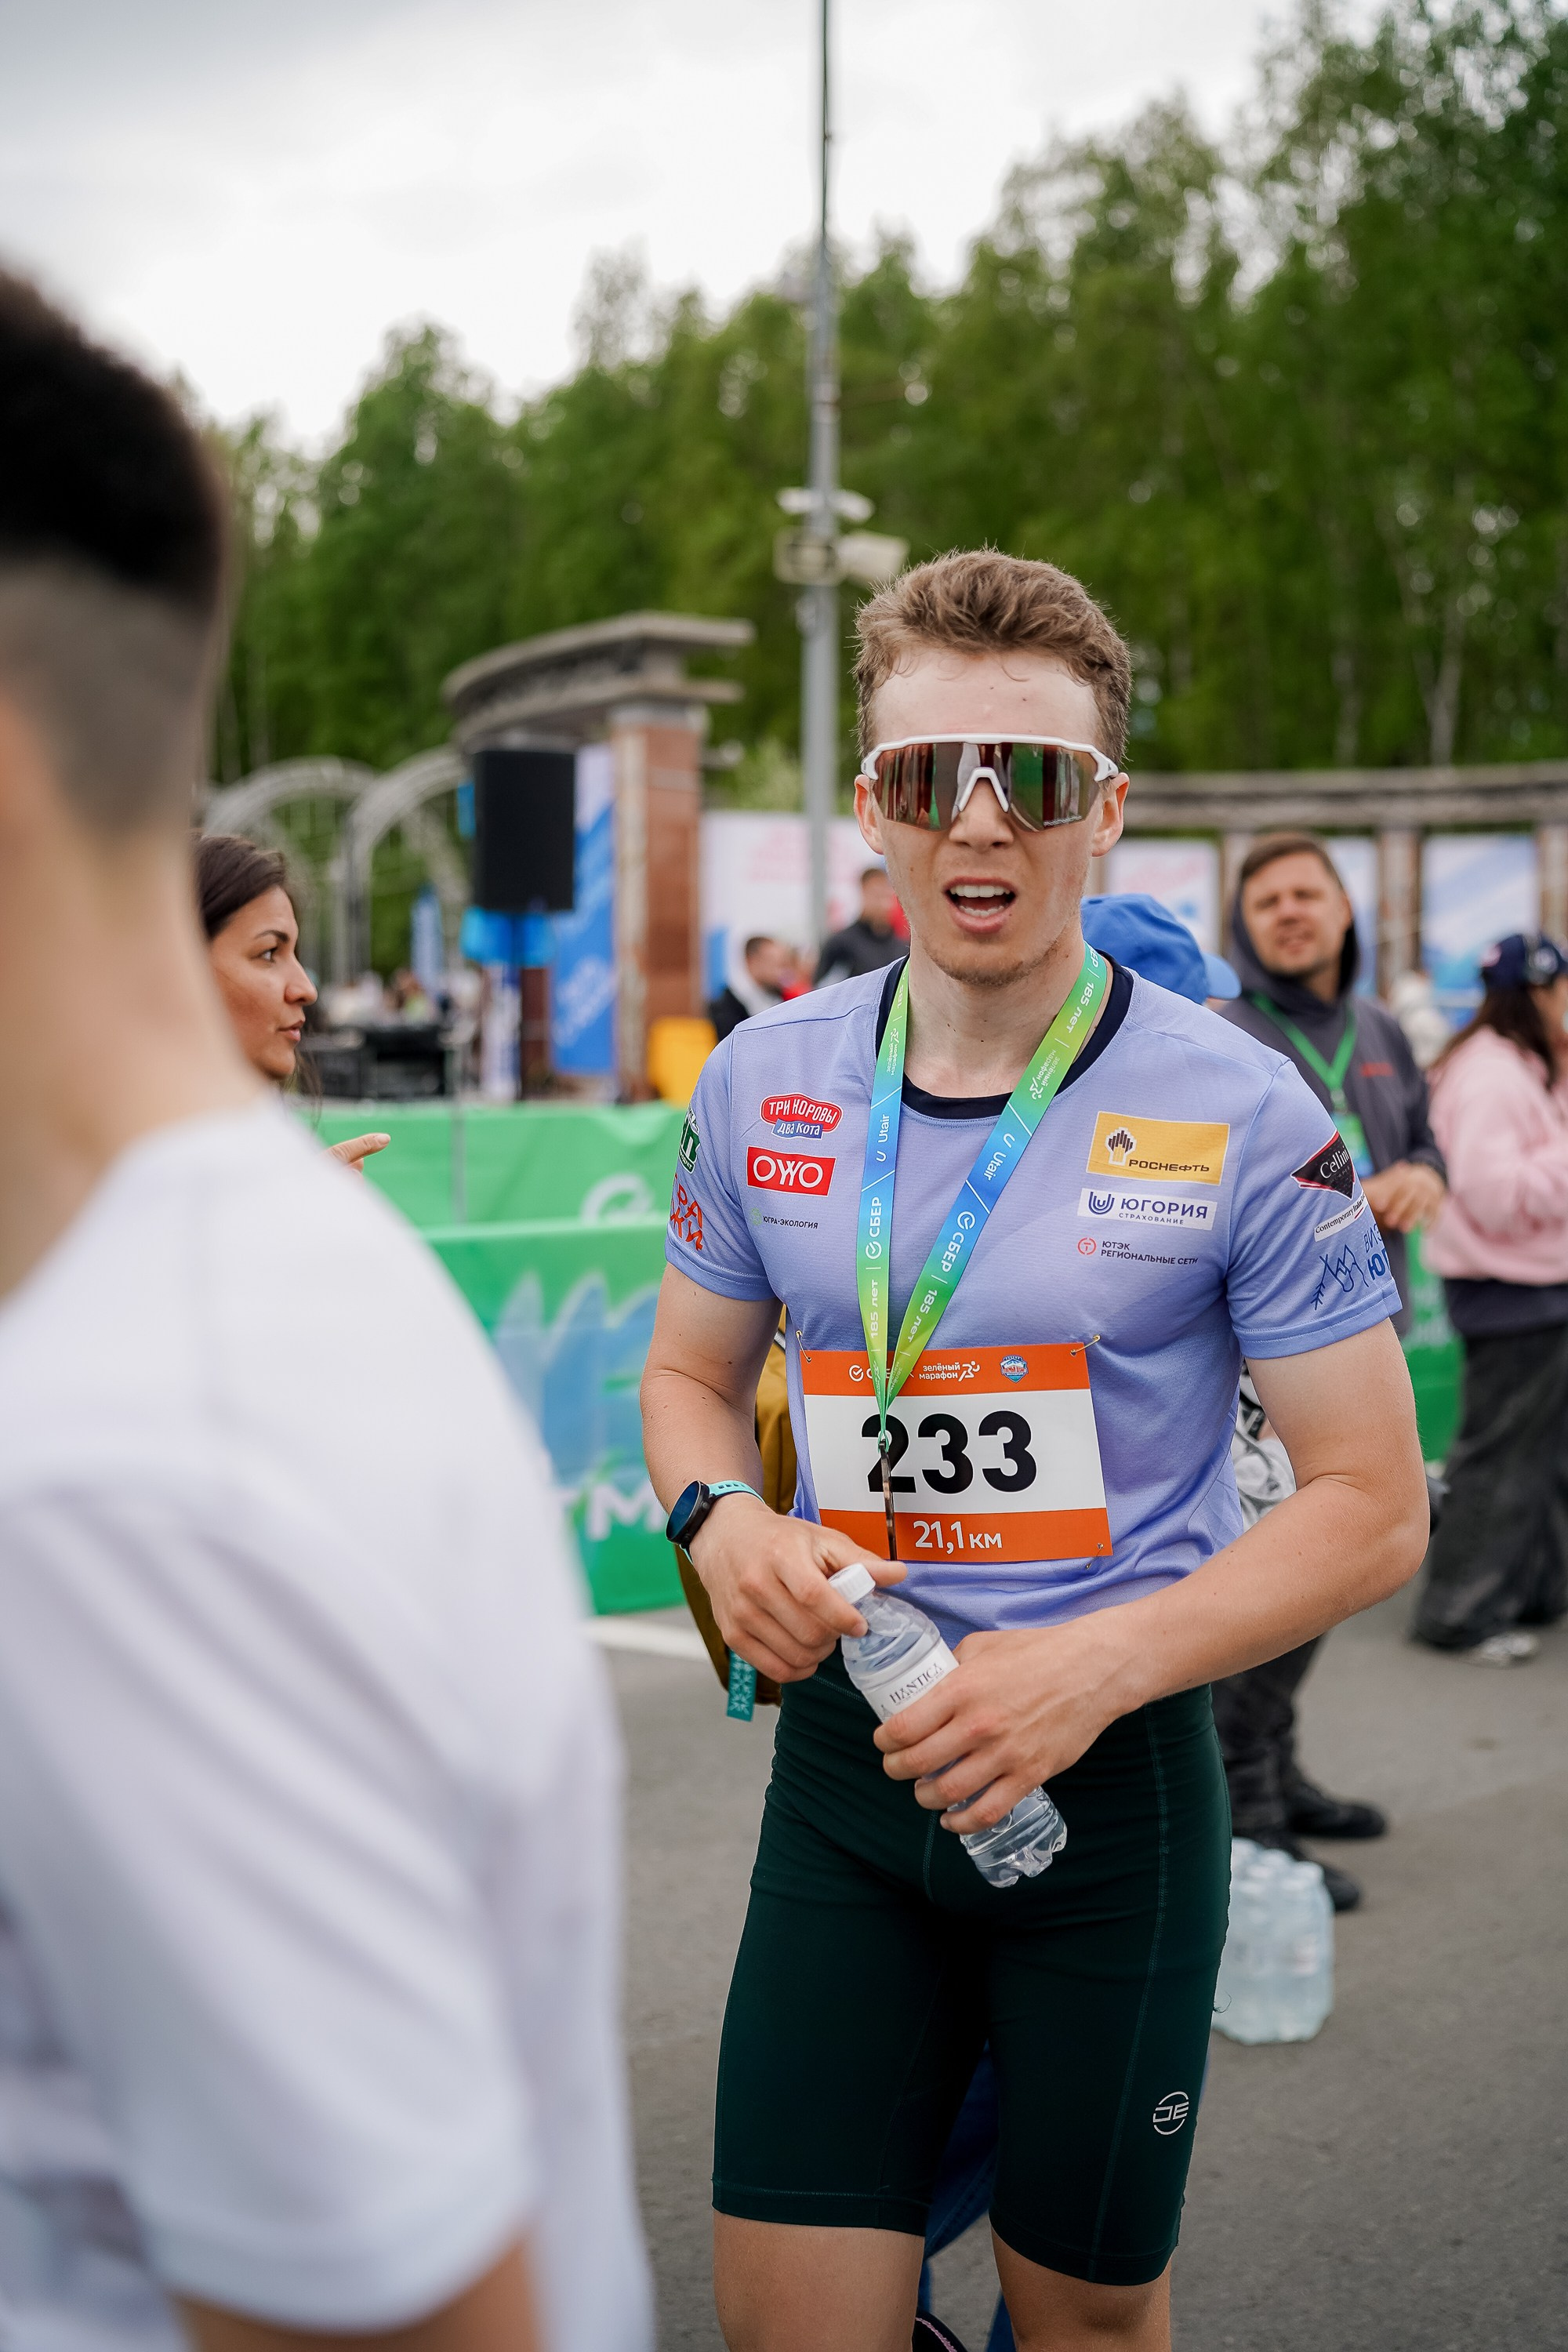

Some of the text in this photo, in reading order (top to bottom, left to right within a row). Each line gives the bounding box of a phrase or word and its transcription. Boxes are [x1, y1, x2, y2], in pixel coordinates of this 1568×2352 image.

[1066, 982, 1094, 1033] 185 лет
[1036, 1050, 1056, 1080] марафон
[769, 1099, 790, 1115] ТРИ
[877, 1114, 890, 1143] Utair
[983, 1151, 1006, 1181] Utair
[1129, 1159, 1210, 1172] РОСНЕФТЬ
[1320, 1145, 1349, 1179] Cellini
[869, 1196, 882, 1237] СБЕР
[1119, 1213, 1184, 1225] СТРАХОВАНИЕ
[1120, 1198, 1208, 1218] ЮГОРИЯ
[1316, 1207, 1354, 1233] Contemporary
[763, 1216, 818, 1229] ЮГРА-ЭКОЛОГИЯ
[942, 1232, 965, 1272] СБЕР
[1101, 1250, 1175, 1265] РЕГИОНАЛЬНЫЕ
[1102, 1241, 1131, 1250] ЮТЭК
[870, 1279, 879, 1307] лет
[908, 1289, 938, 1342] 185 лет
[919, 1370, 958, 1381] марафон
[923, 1362, 960, 1372] зелёный
[861, 1410, 1037, 1494] 233
[913, 1520, 964, 1555] 21,1
